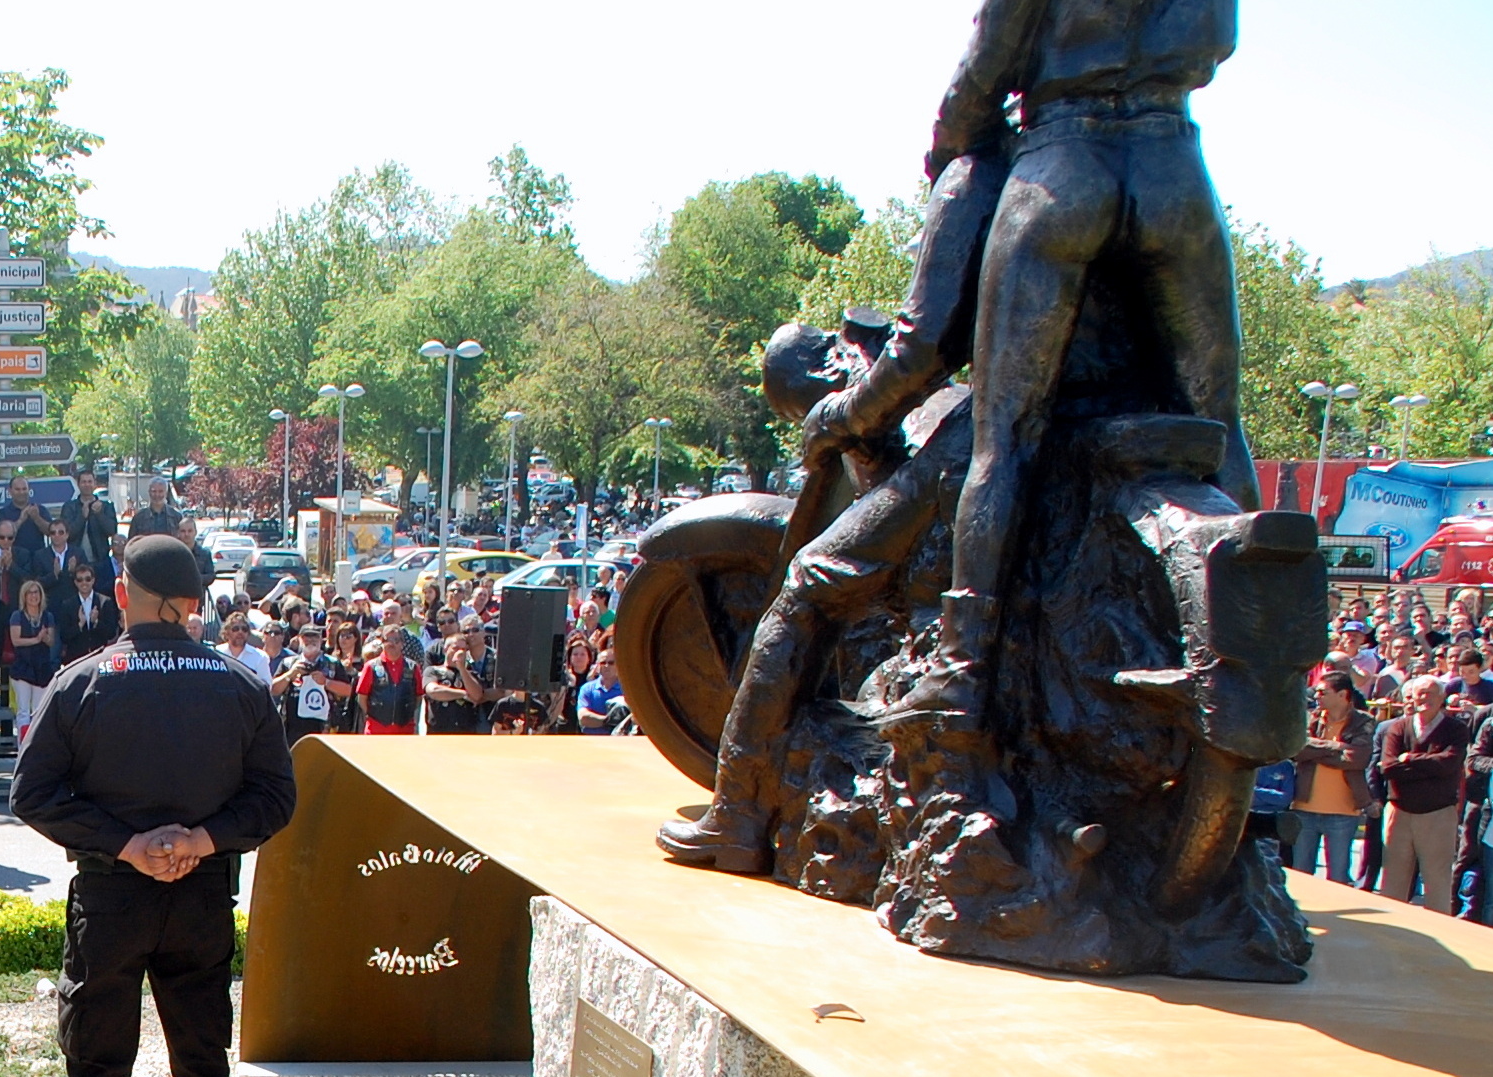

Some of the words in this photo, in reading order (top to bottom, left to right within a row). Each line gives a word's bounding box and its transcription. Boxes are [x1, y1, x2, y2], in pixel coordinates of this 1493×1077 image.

[0, 310, 40, 326] justiça
[6, 445, 29, 455] centro
[30, 442, 61, 455] histórico
[98, 653, 176, 675] SEGURANÇA
[177, 656, 228, 672] PRIVADA
